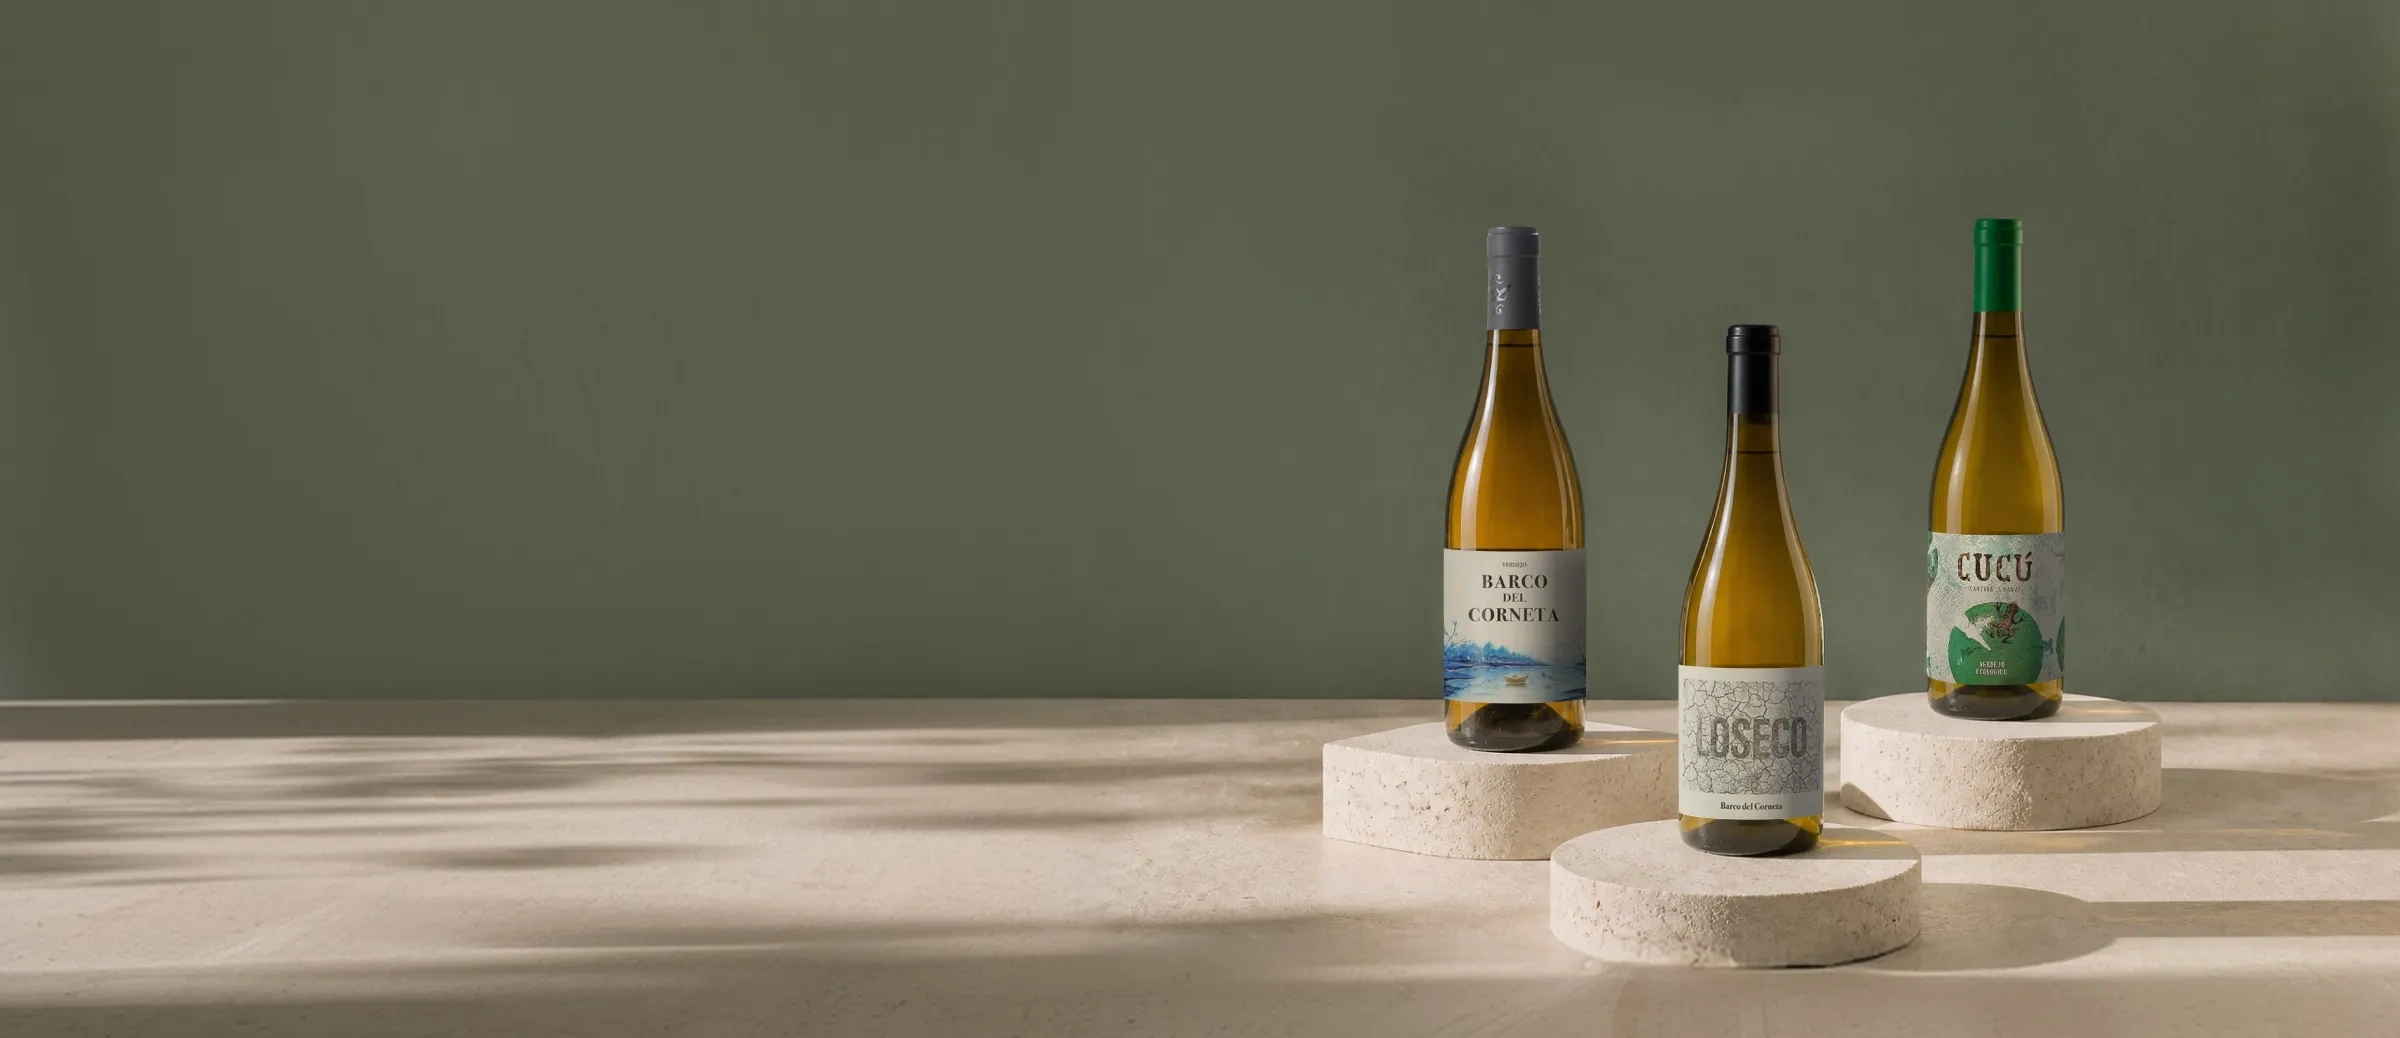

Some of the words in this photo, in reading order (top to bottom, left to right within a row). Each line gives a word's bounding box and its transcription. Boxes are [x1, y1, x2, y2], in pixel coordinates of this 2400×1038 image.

[1957, 551, 2033, 582] CUCÚ
[1482, 574, 1548, 589] BARCO
[1503, 593, 1527, 602] DEL
[1468, 607, 1559, 622] CORNETA
[1696, 717, 1807, 759] LOSECO
[1720, 801, 1741, 810] Barco
[1742, 802, 1753, 810] del
[1754, 802, 1783, 810] Corneta
